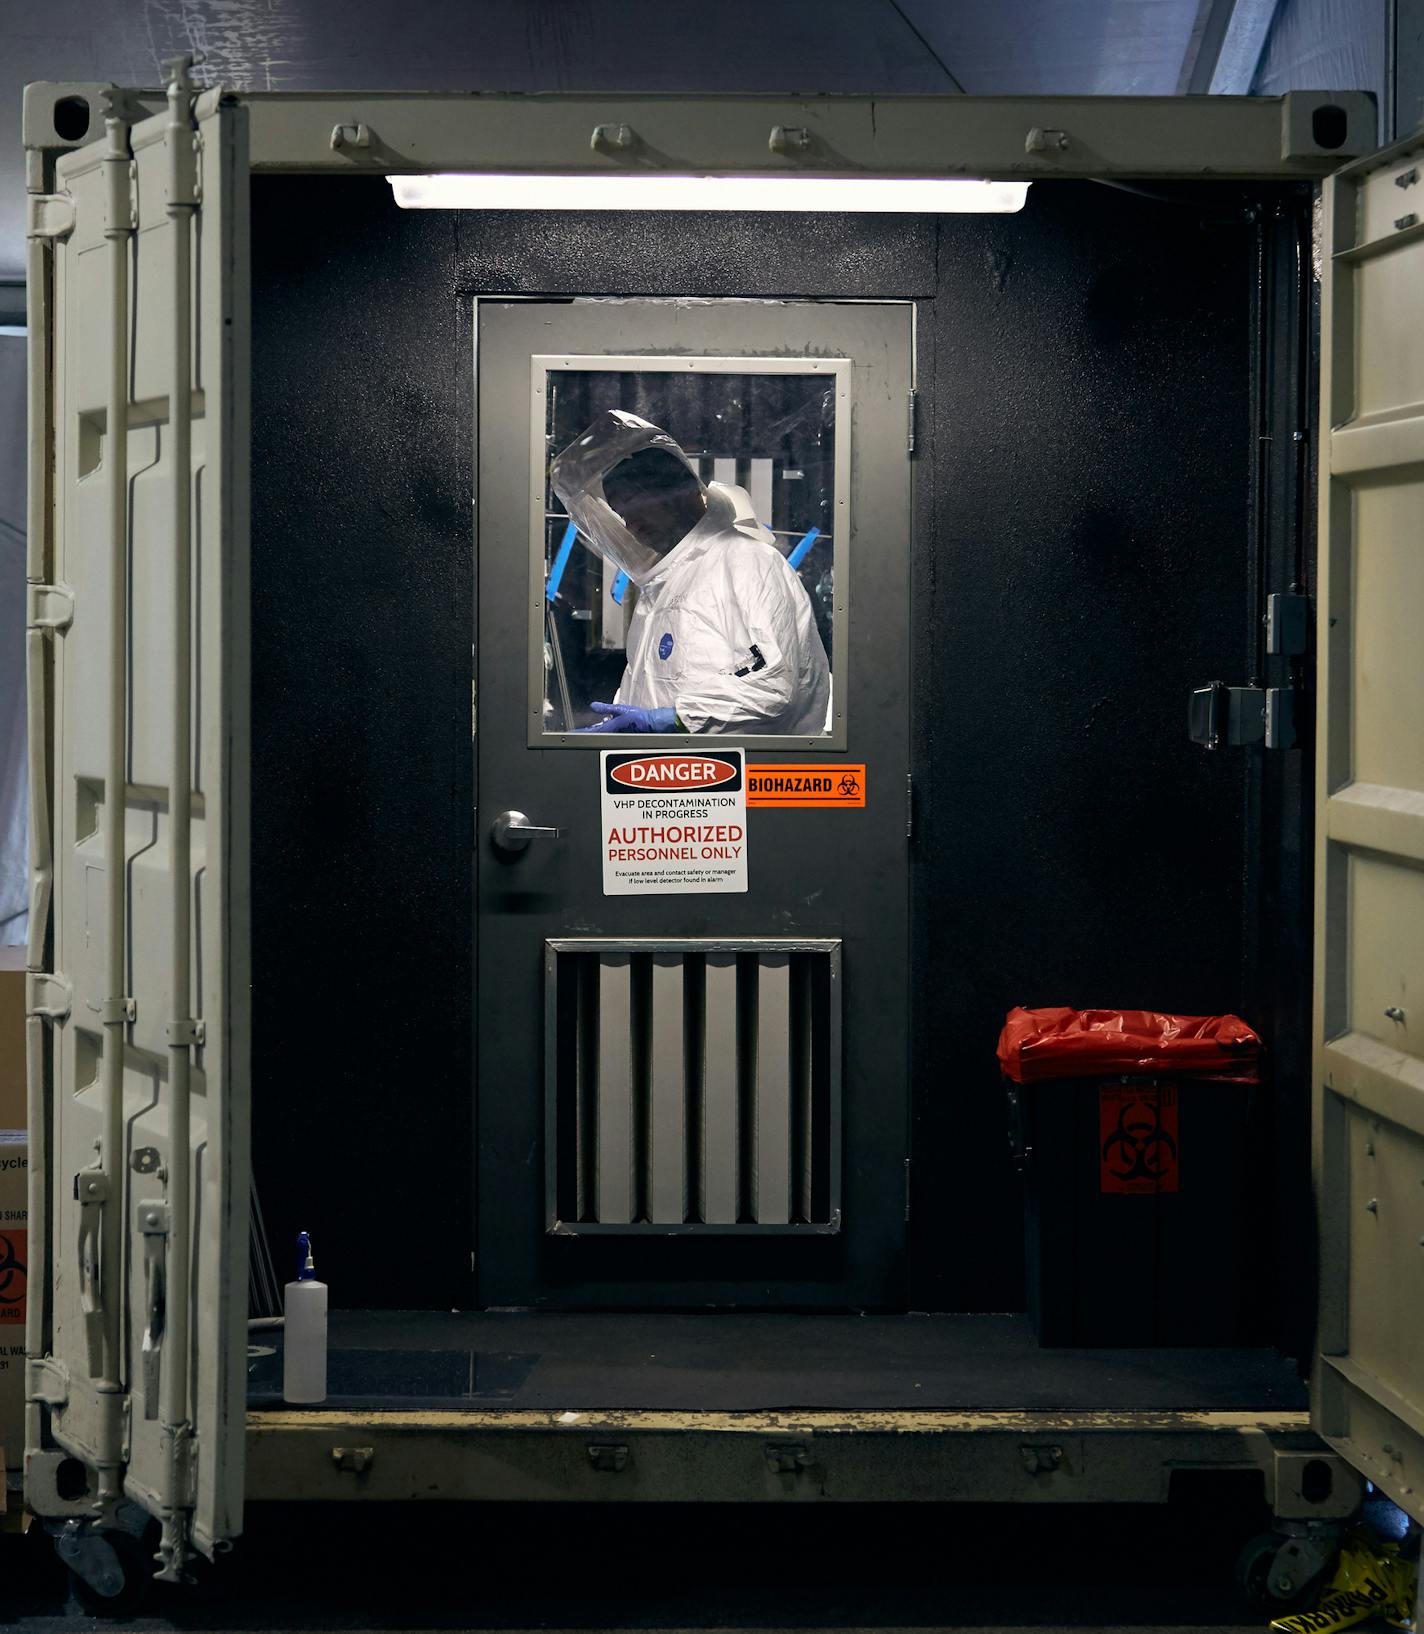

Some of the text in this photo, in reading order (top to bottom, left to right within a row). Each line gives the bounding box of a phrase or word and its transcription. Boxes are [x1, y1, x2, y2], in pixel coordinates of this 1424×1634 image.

[630, 763, 717, 782] DANGER
[748, 778, 832, 792] BIOHAZARD
[613, 798, 736, 809] VHP DECONTAMINATION
[642, 809, 709, 819] IN PROGRESS
[608, 825, 743, 845] AUTHORIZED
[609, 846, 742, 861] PERSONNEL ONLY
[687, 869, 704, 877] safety
[0, 1156, 27, 1171] ycle
